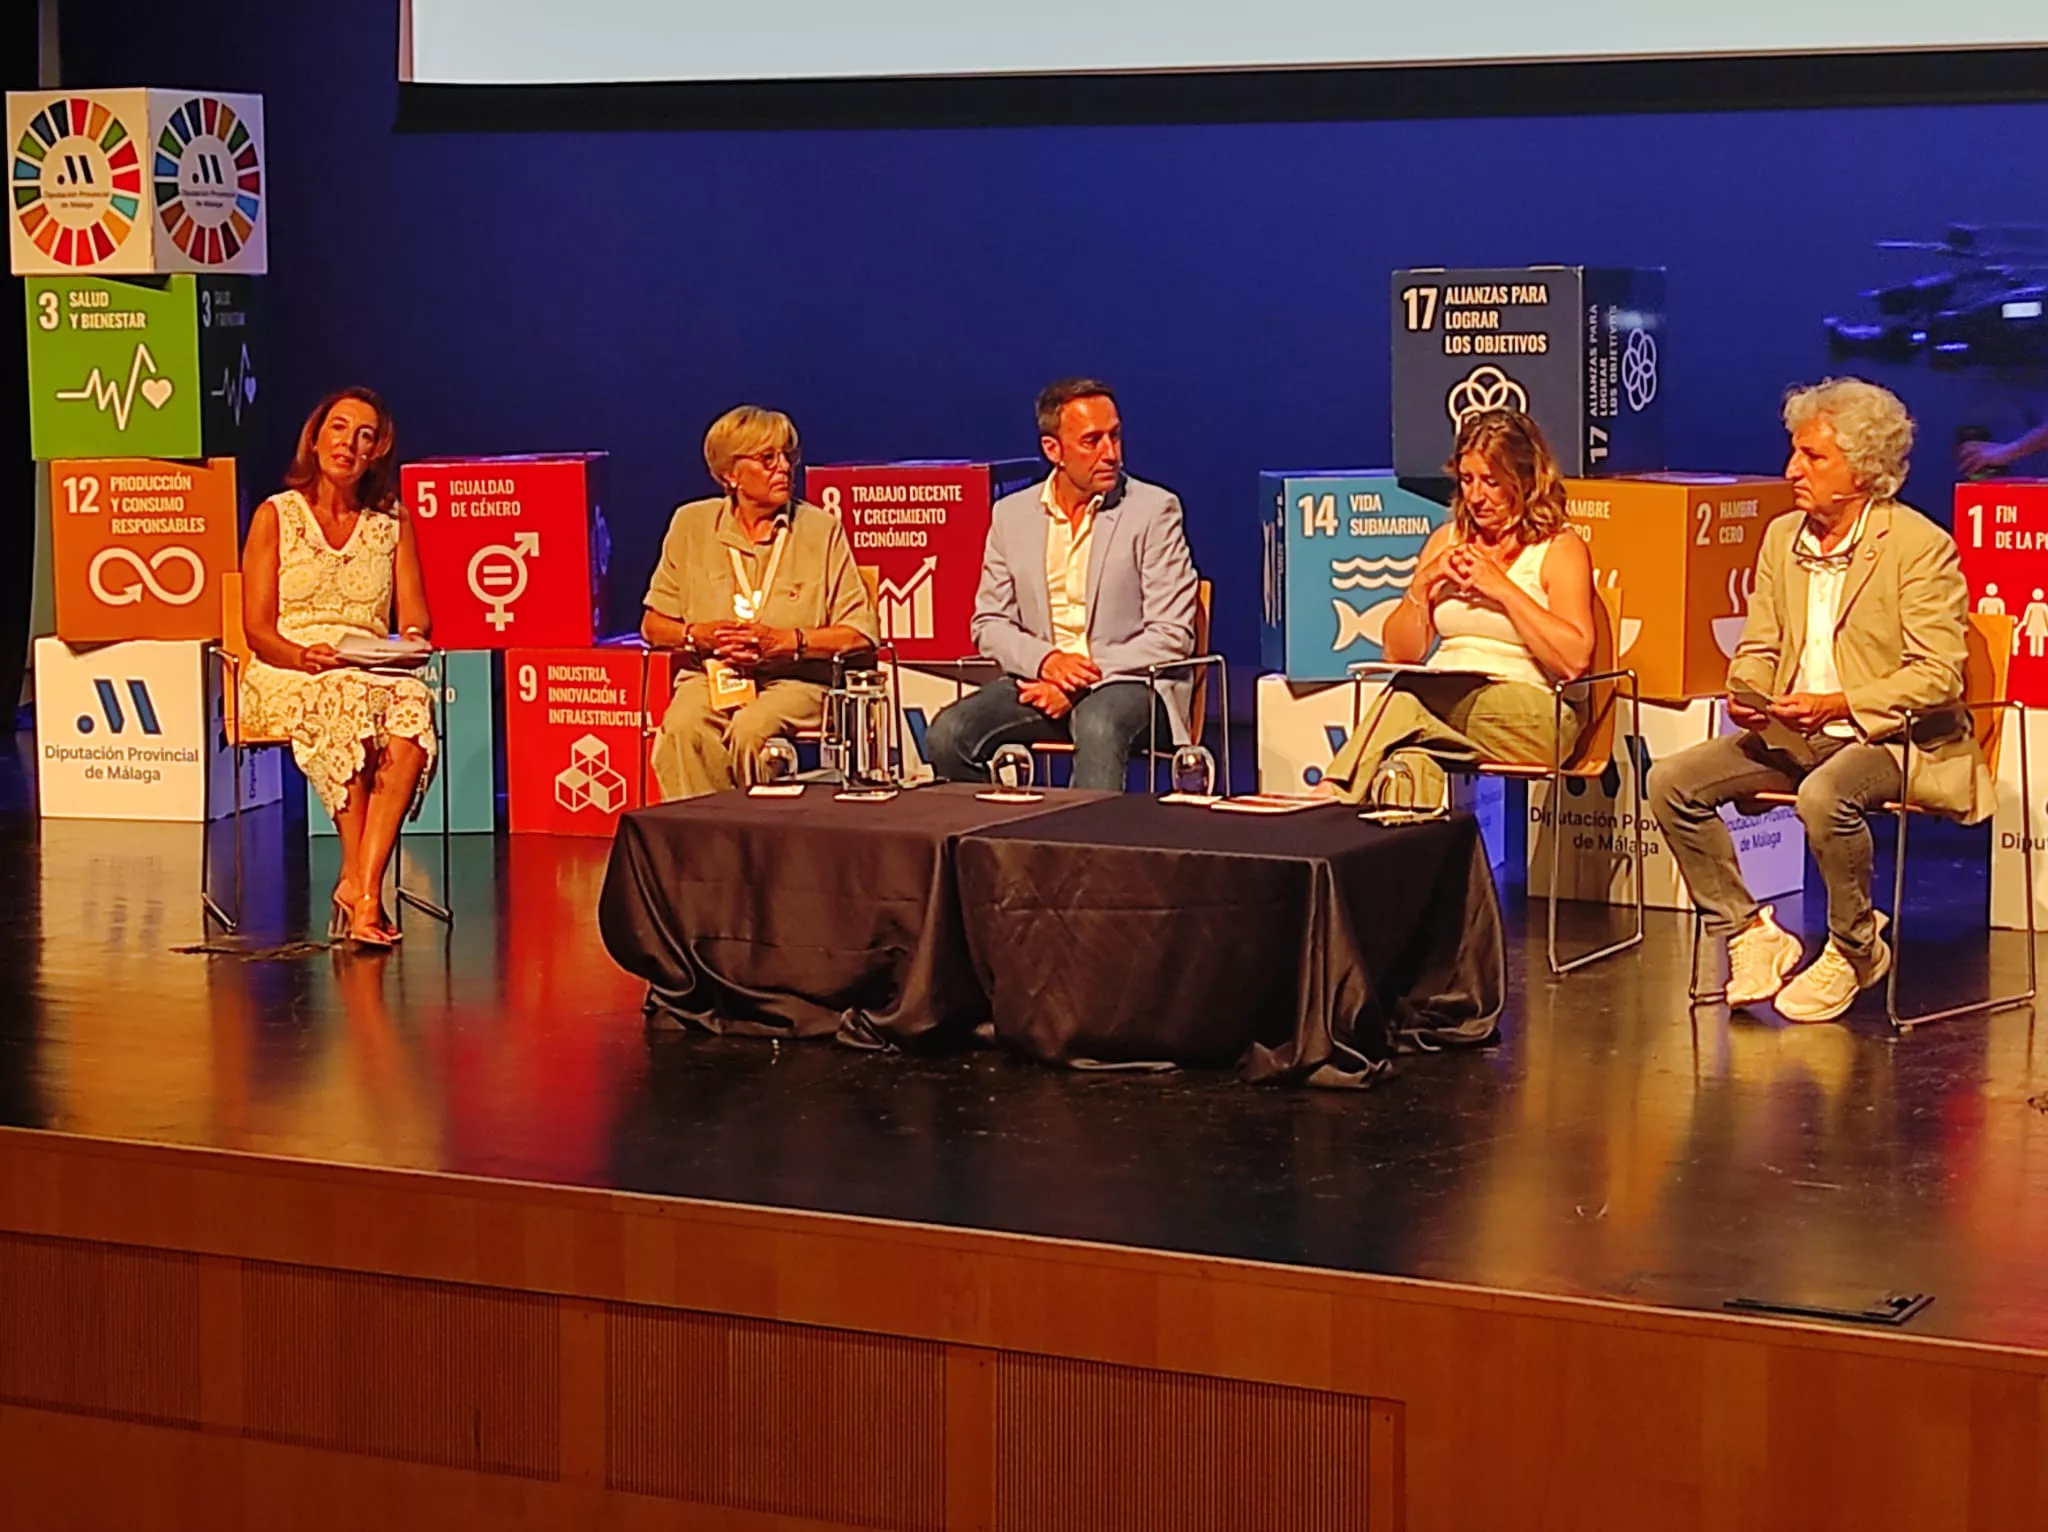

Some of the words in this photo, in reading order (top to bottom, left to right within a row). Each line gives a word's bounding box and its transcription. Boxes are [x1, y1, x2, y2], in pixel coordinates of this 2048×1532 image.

[68, 291, 110, 308] SALUD
[1445, 286, 1508, 305] ALIANZAS
[1512, 285, 1548, 304] PARA
[38, 291, 60, 330] 3
[202, 290, 212, 328] 3
[1403, 287, 1438, 330] 17
[69, 312, 79, 330] Y
[81, 312, 146, 329] BIENESTAR
[1445, 311, 1499, 330] LOGRAR
[1589, 304, 1598, 344] PARA
[1445, 335, 1472, 354] LOS
[1474, 334, 1548, 354] OBJETIVOS
[1589, 347, 1598, 417] ALIANZAS
[1609, 387, 1618, 417] LOS
[1589, 425, 1609, 464] 17
[110, 472, 192, 492] PRODUCCIÓN
[449, 479, 515, 496] IGUALDAD
[63, 476, 100, 514] 12
[417, 481, 438, 518] 5
[822, 486, 842, 518] 8
[851, 486, 907, 503] TRABAJO
[909, 484, 964, 502] DECENTE
[1350, 494, 1383, 512] VIDA
[111, 497, 120, 513] Y
[122, 496, 184, 513] CONSUMO
[451, 502, 468, 518] DE
[470, 498, 521, 517] GÉNERO
[1719, 500, 1759, 519] HAMBRE
[1995, 504, 2018, 524] FIN
[111, 517, 206, 535] RESPONSABLES
[852, 508, 862, 526] Y
[863, 507, 947, 525] CRECIMIENTO
[1298, 495, 1339, 537] 14
[1696, 502, 1712, 546] 2
[1968, 504, 1983, 548] 1
[1350, 517, 1431, 537] SUBMARINA
[1718, 525, 1745, 545] CERO
[853, 527, 928, 548] ECONÓMICO
[1995, 530, 2013, 550] DE
[2015, 531, 2033, 550] LA
[518, 664, 538, 702] 9
[547, 665, 612, 684] INDUSTRIA,
[548, 684, 617, 705] INNOVACIÓN
[619, 688, 628, 705] E
[44, 744, 124, 763] Diputación
[127, 745, 199, 763] Provincial
[84, 765, 103, 780] de
[106, 764, 161, 784] Málaga
[1573, 832, 1594, 850] de
[1599, 832, 1659, 857] Málaga
[1740, 836, 1750, 852] de
[1752, 831, 1781, 849] Málaga
